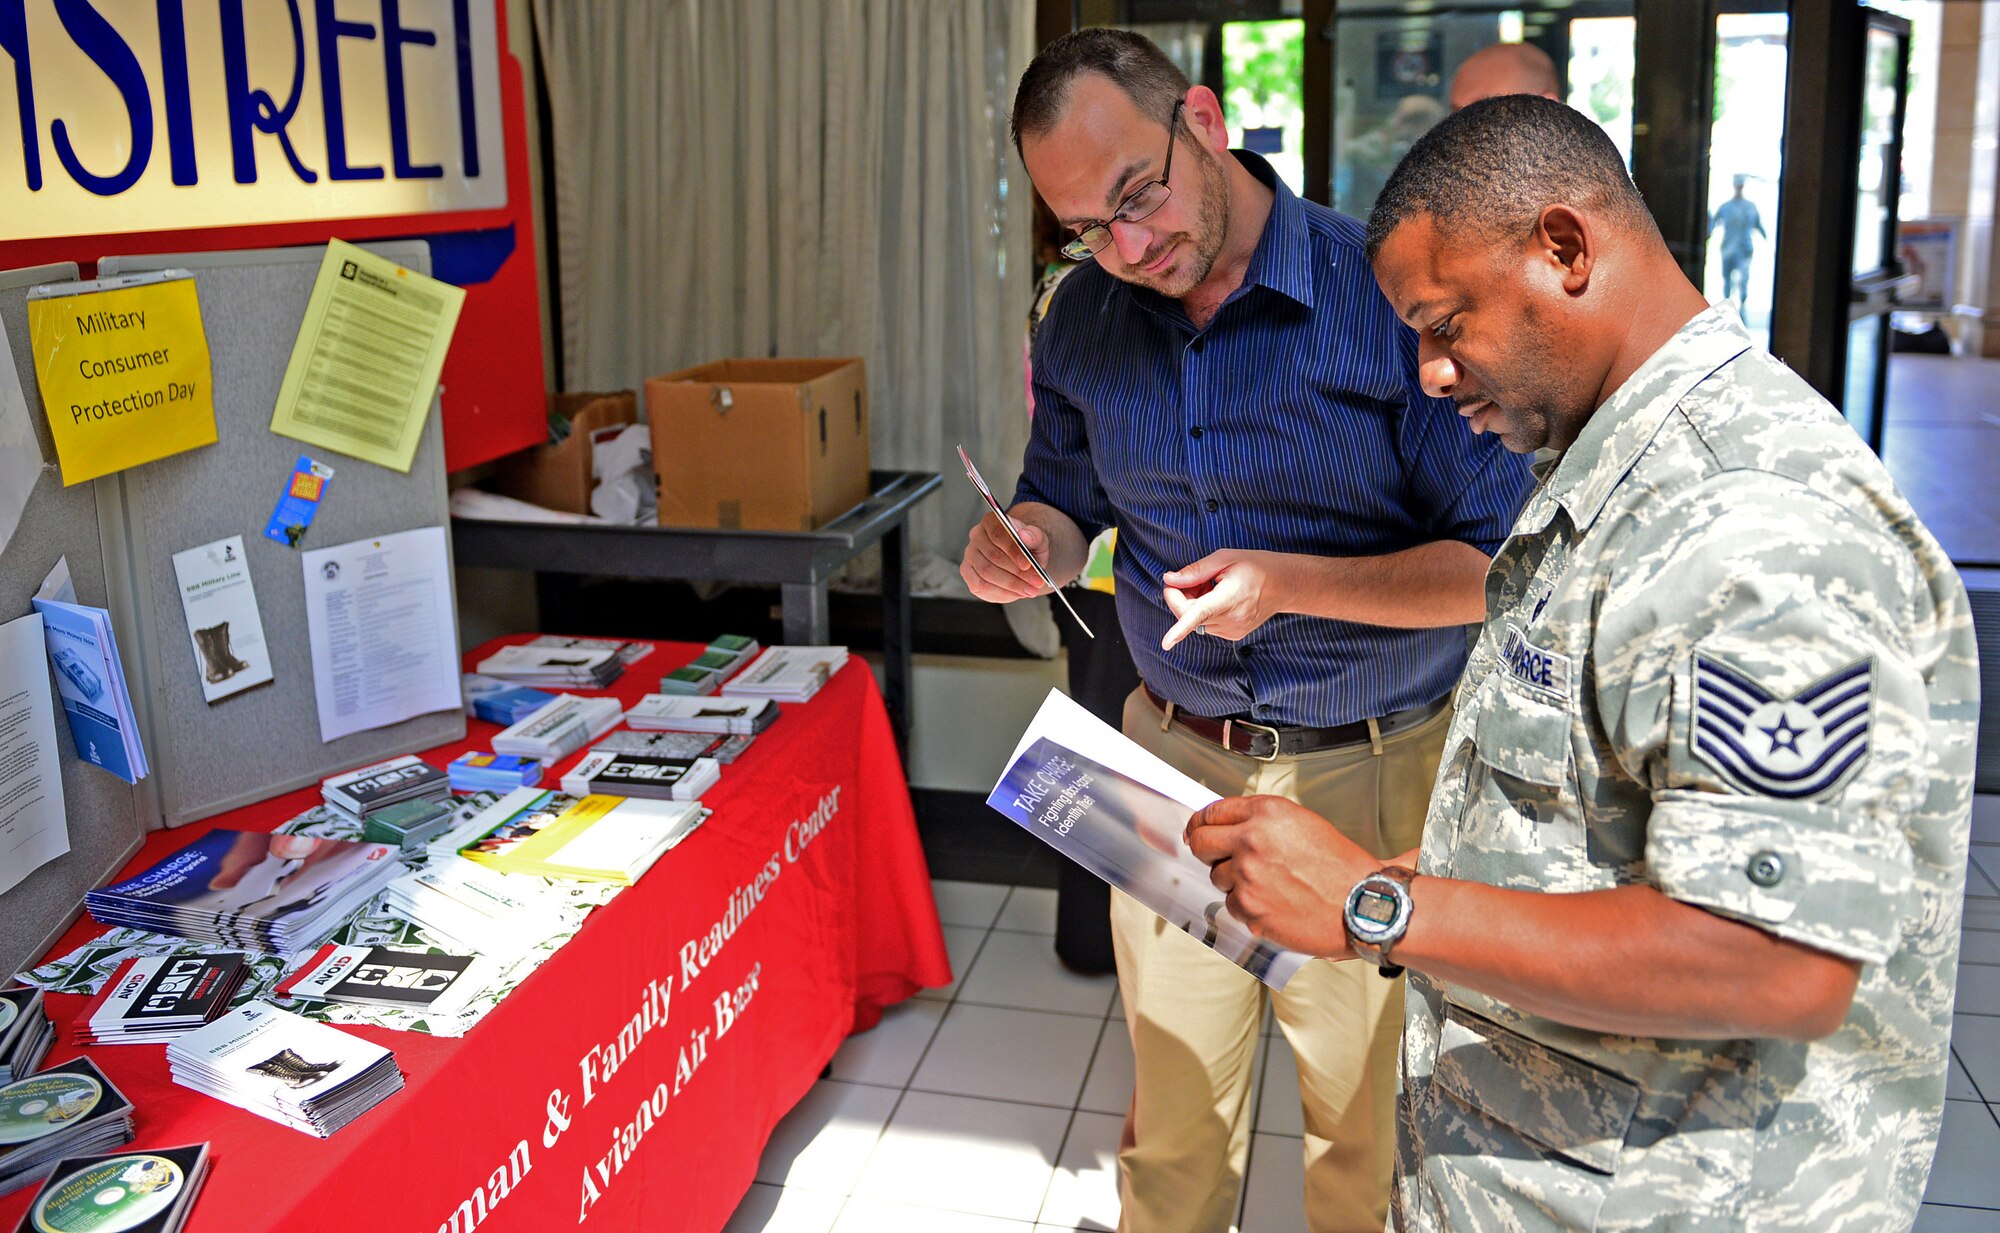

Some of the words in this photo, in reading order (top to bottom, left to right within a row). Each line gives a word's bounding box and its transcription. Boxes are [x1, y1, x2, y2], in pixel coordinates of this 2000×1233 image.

[0, 0, 480, 195] STREET
[76, 310, 146, 336] Military
[79, 348, 169, 380] Consumer
[71, 390, 164, 425] Protection
[168, 382, 196, 402] Day
[201, 575, 225, 587] Military
[226, 571, 241, 580] Line
[1012, 778, 1049, 814] TAKE
[1038, 794, 1072, 828] Fighting
[1054, 805, 1087, 838] Identity
[314, 955, 353, 986] AVOID
[542, 1088, 572, 1149] &
[578, 975, 674, 1108] Family
[678, 852, 781, 992] Readiness
[784, 784, 841, 864] Center
[118, 973, 146, 1000] AVOID
[208, 1042, 229, 1054] BBB
[228, 1027, 260, 1046] Military
[257, 1016, 278, 1030] Line
[577, 1082, 669, 1224] Aviano
[673, 1025, 710, 1097] Air
[62, 1177, 86, 1195] How
[69, 1184, 97, 1205] Service
[96, 1166, 129, 1188] Members
[85, 1165, 118, 1189] Money
